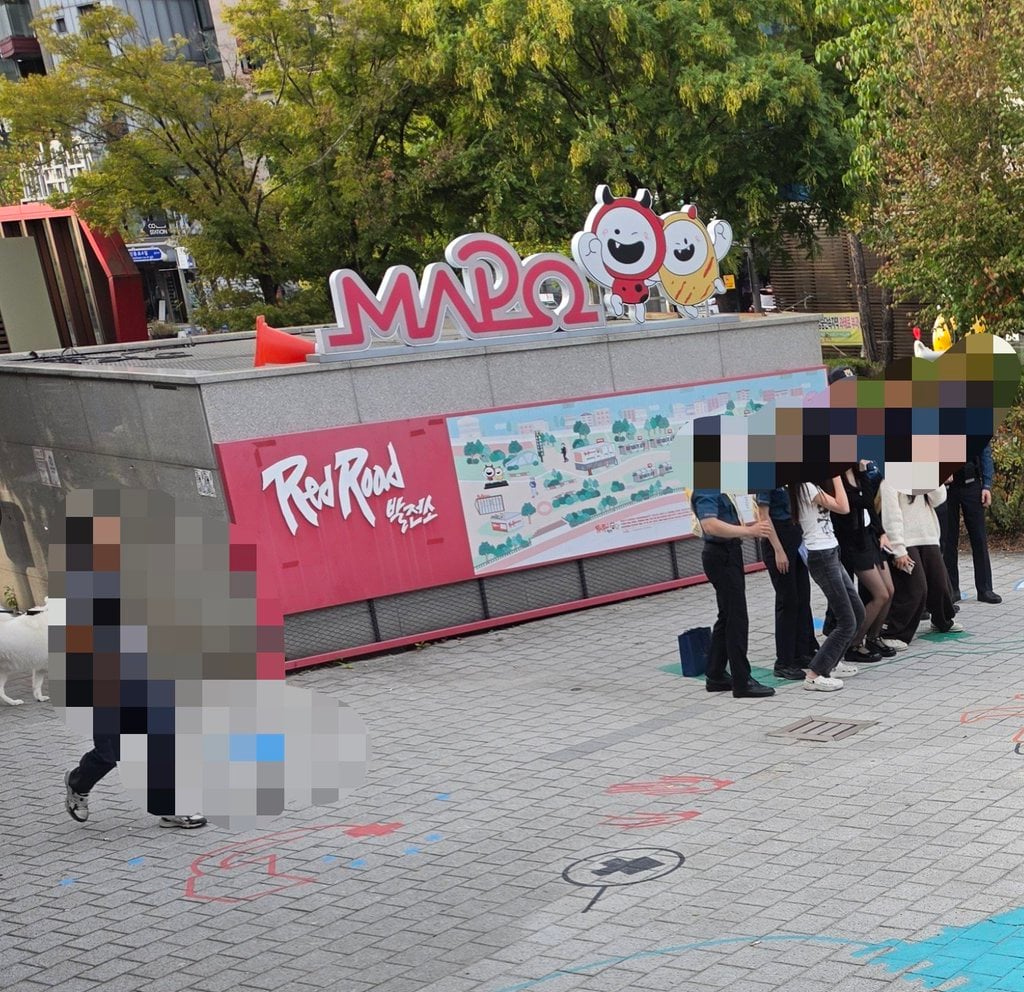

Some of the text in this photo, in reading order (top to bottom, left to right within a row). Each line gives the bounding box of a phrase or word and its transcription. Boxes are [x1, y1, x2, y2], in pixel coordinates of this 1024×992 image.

[326, 236, 602, 349] MAPO
[261, 441, 406, 537] Red Road
[386, 494, 439, 534] 발전소
